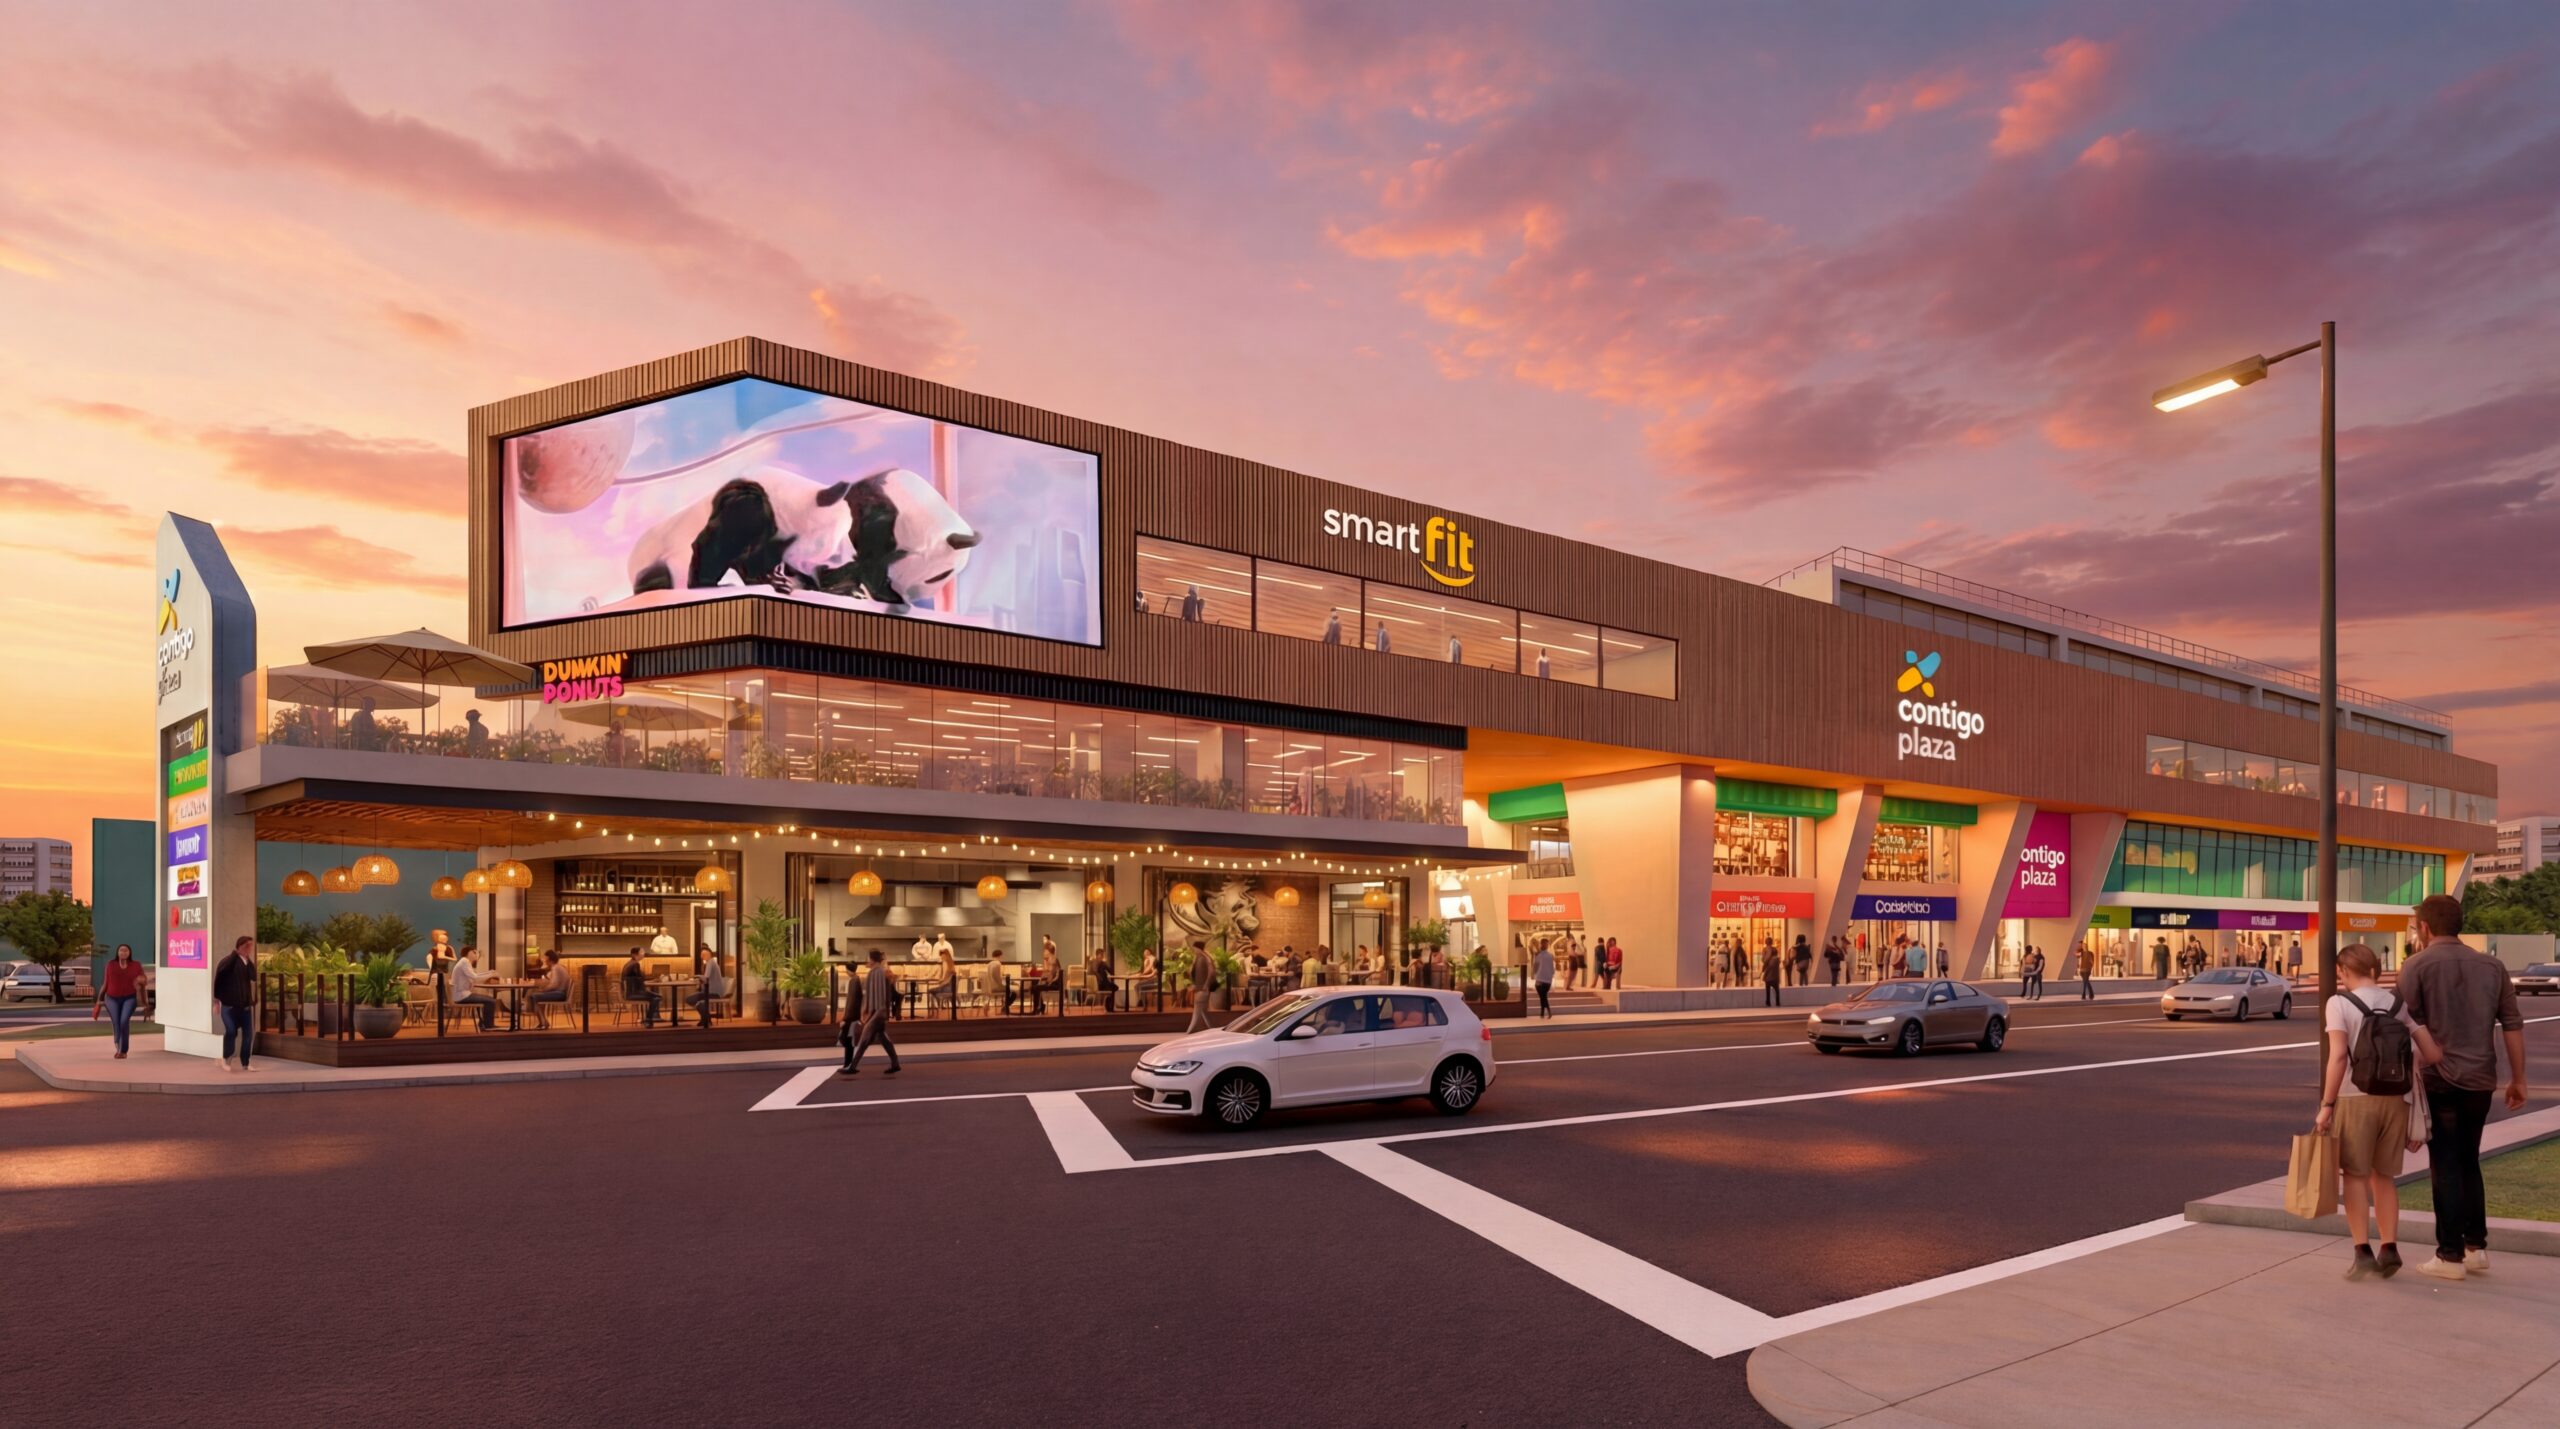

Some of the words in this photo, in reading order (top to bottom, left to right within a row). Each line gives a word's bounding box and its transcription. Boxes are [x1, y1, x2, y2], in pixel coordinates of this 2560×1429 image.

[1898, 699, 1985, 740] contigo
[1898, 726, 1957, 761] plaza
[2020, 845, 2065, 869] ontigo
[2021, 865, 2057, 889] plaza
